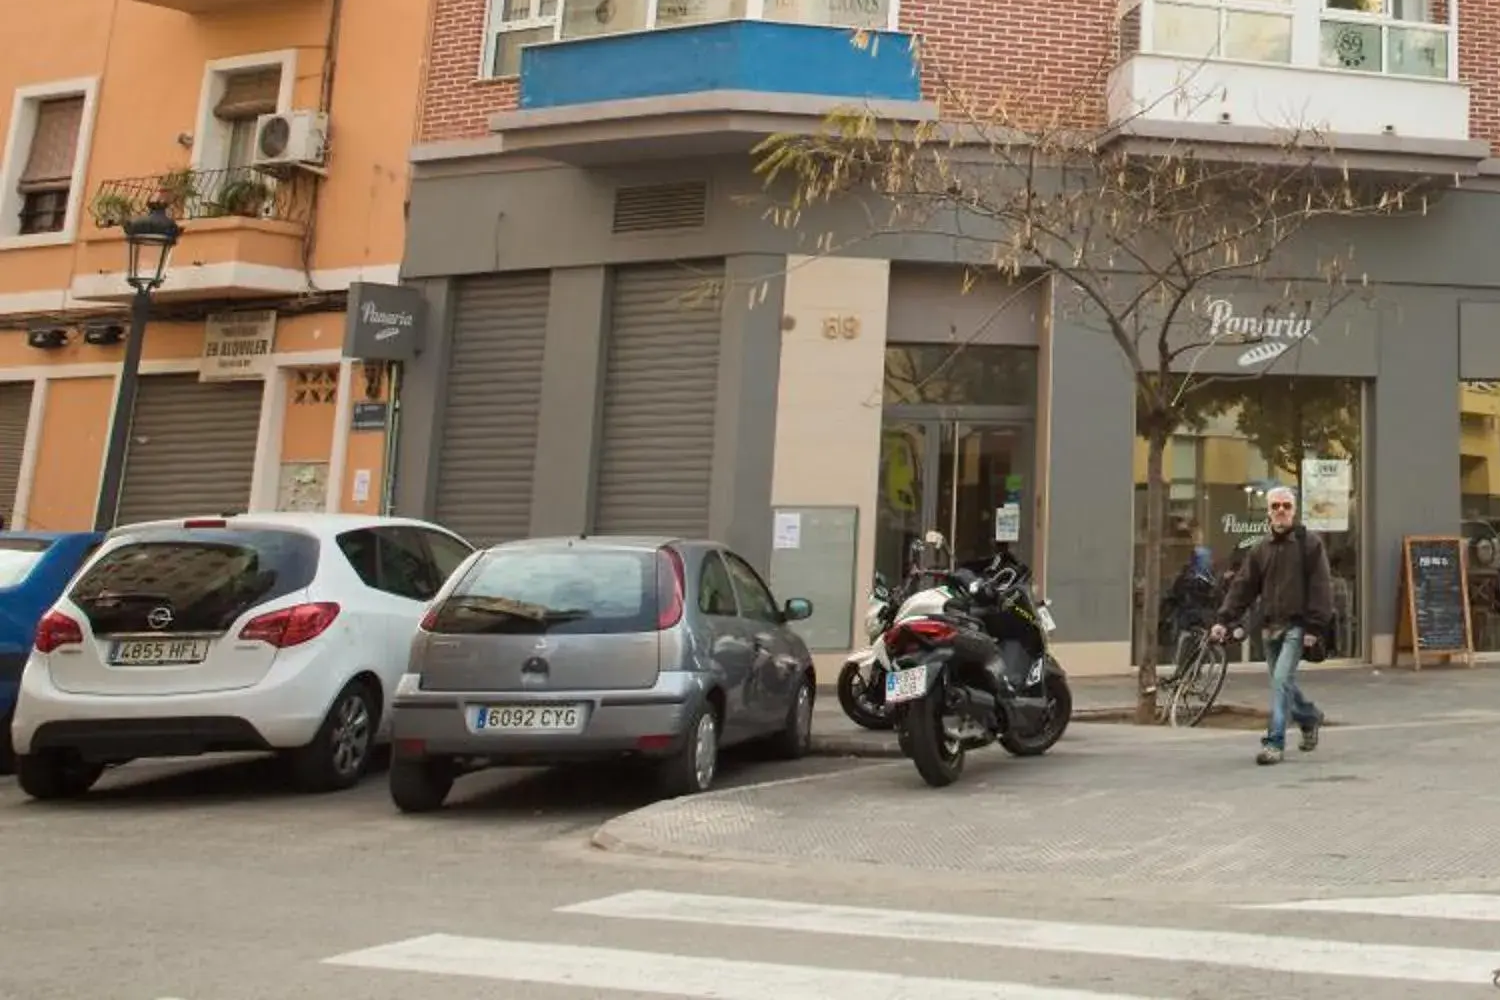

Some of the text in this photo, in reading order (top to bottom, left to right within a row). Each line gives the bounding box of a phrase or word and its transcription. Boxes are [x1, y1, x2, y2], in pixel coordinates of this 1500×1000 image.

[361, 300, 414, 326] Panaria
[1207, 299, 1312, 338] Panaria
[1220, 513, 1269, 534] Panari
[488, 708, 577, 728] 6092 CYG
